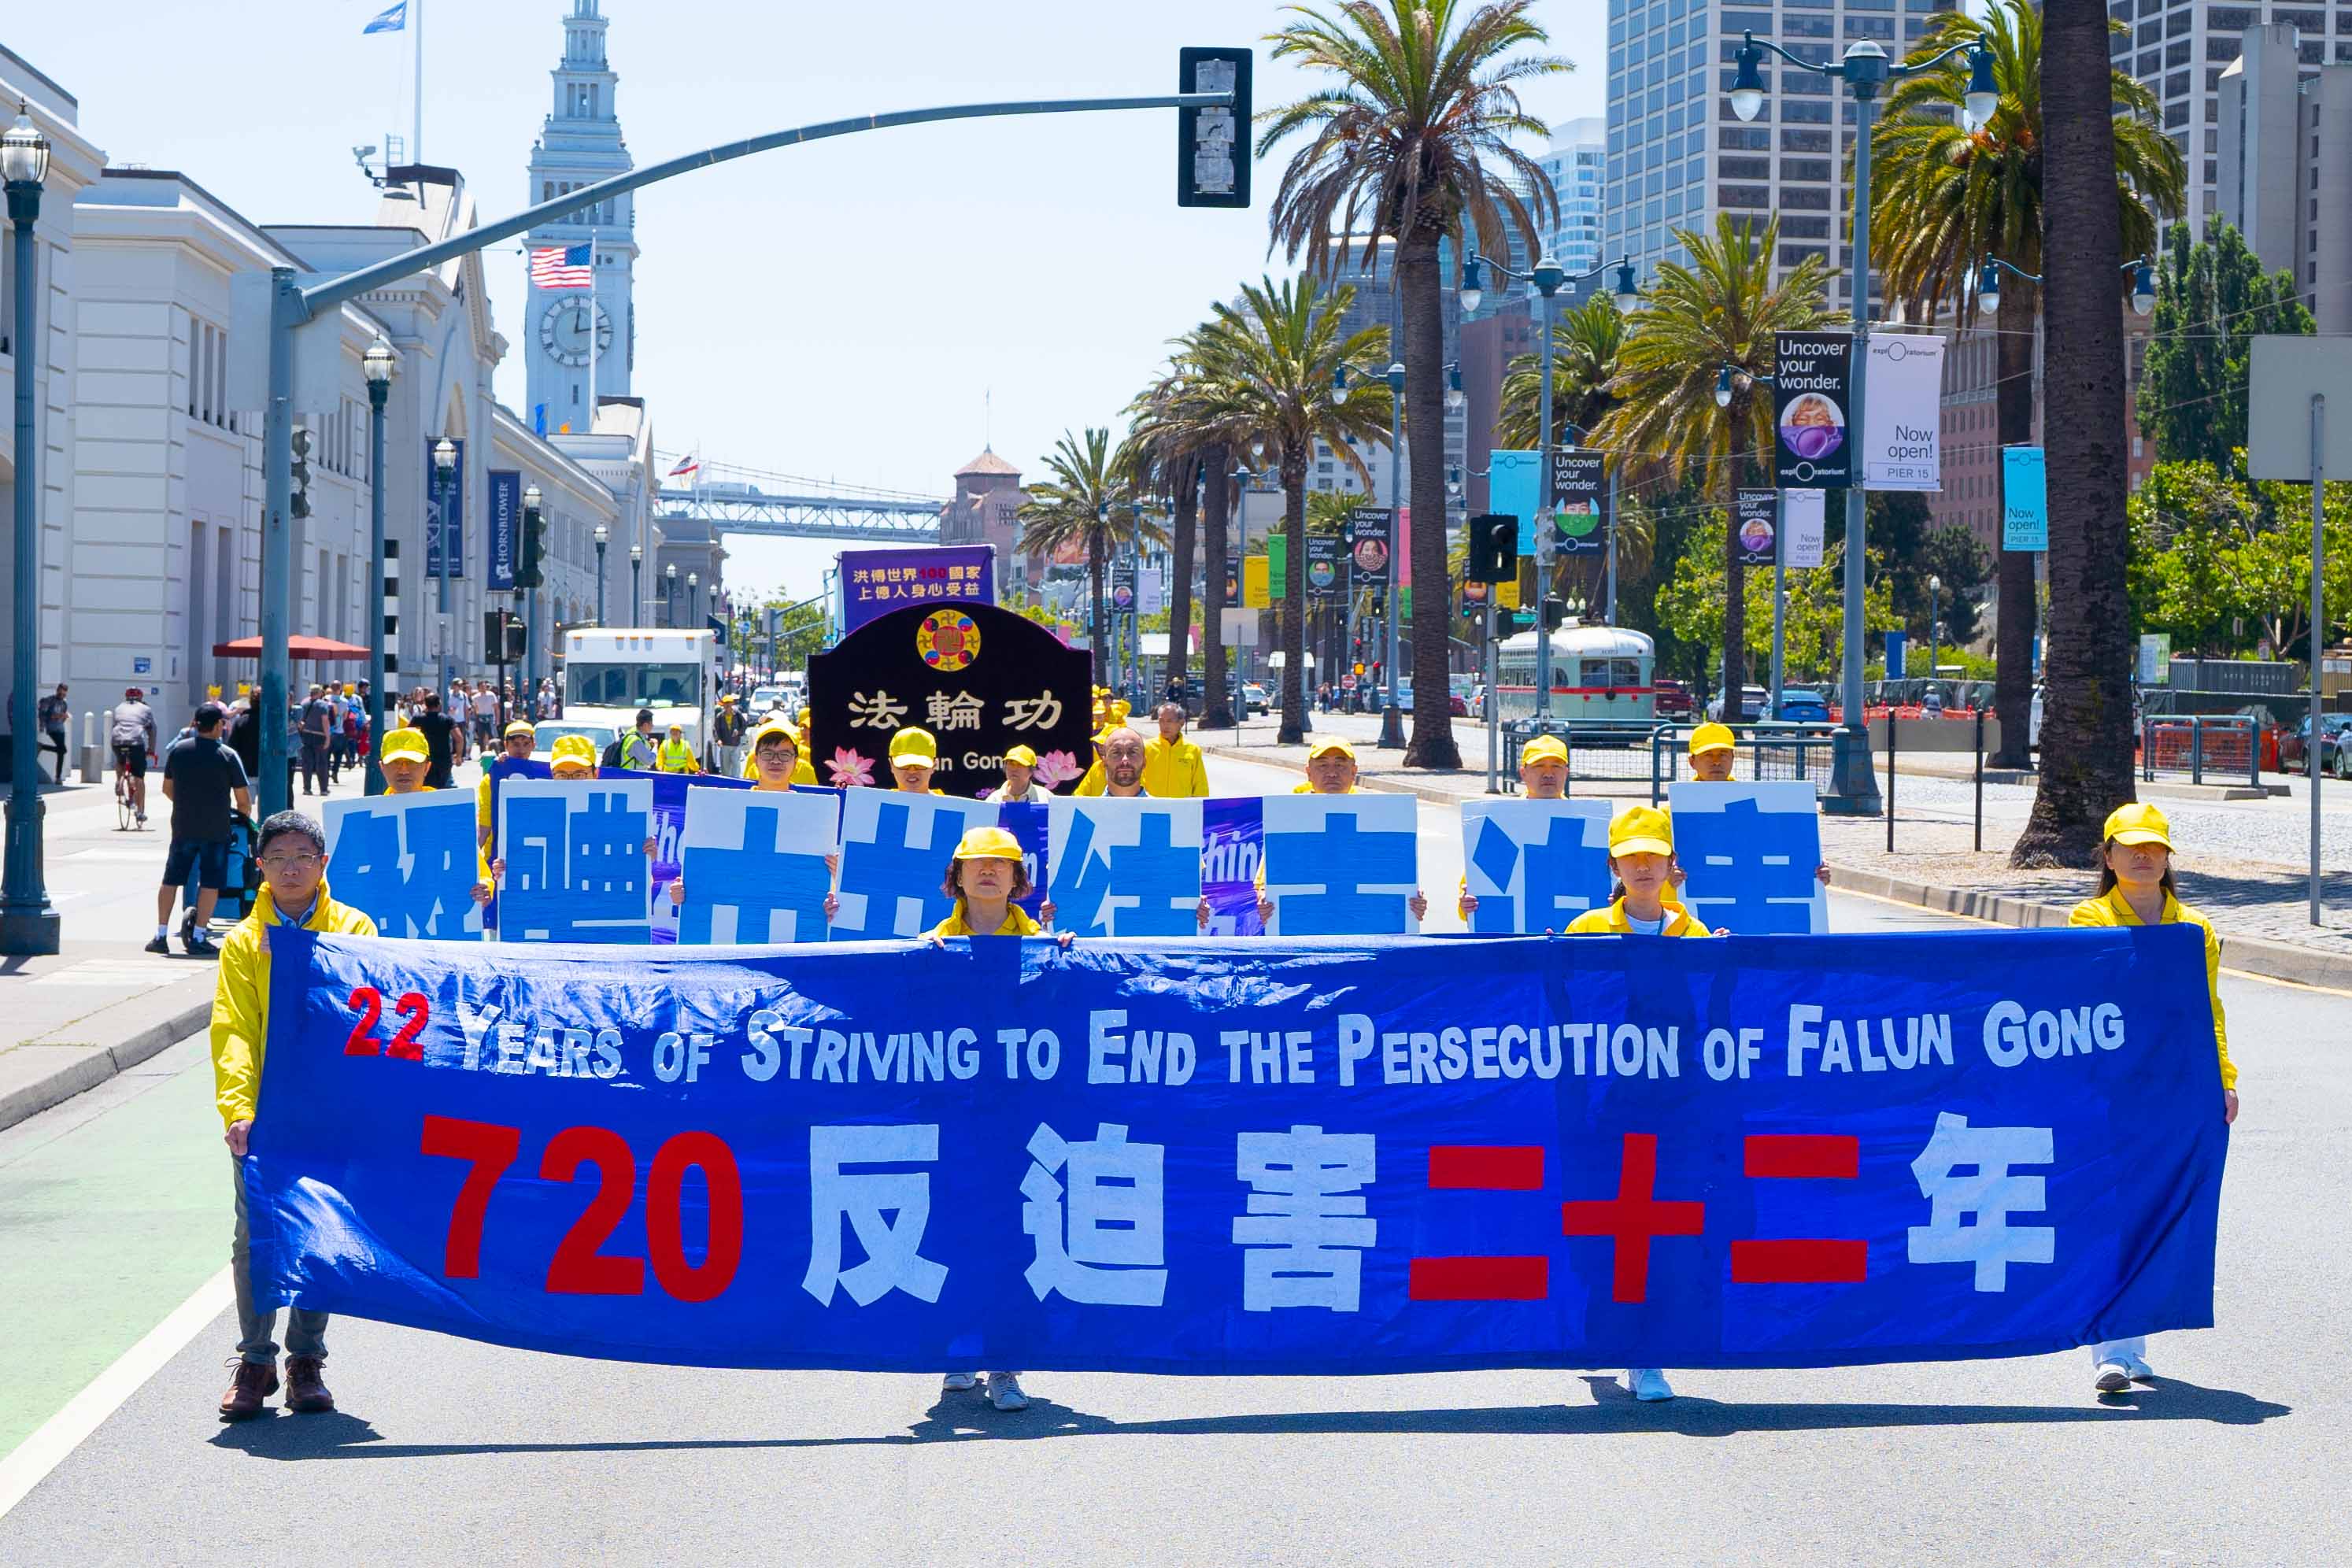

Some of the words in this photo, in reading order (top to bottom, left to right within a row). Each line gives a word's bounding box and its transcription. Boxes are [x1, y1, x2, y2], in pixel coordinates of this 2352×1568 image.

[1780, 339, 1846, 356] Uncover
[1780, 360, 1815, 376] your
[1780, 374, 1841, 390] wonder.
[1895, 425, 1933, 442] Now
[1888, 443, 1933, 462] open!
[1555, 456, 1601, 468] Uncover
[1555, 470, 1580, 481] your
[1888, 468, 1914, 479] PIER
[1917, 468, 1929, 479] 15
[1555, 479, 1598, 490] wonder.
[1355, 510, 1389, 520] Uncover
[2008, 508, 2035, 519] Now
[498, 482, 508, 562] HORNBLOWER
[1355, 520, 1374, 530] your
[2008, 520, 2040, 532] open!
[1308, 538, 1336, 546] Uncover
[1800, 534, 1821, 542] Now
[1796, 543, 1821, 552] open!
[858, 582, 981, 601] 上億人身心受益
[848, 690, 1063, 731] 法輪功
[963, 751, 1004, 770] Gon
[343, 986, 429, 1061] 22
[653, 1031, 714, 1082] OF
[997, 1028, 1060, 1081] TO
[1220, 1030, 1315, 1084] THE
[1703, 1028, 1764, 1082] OF
